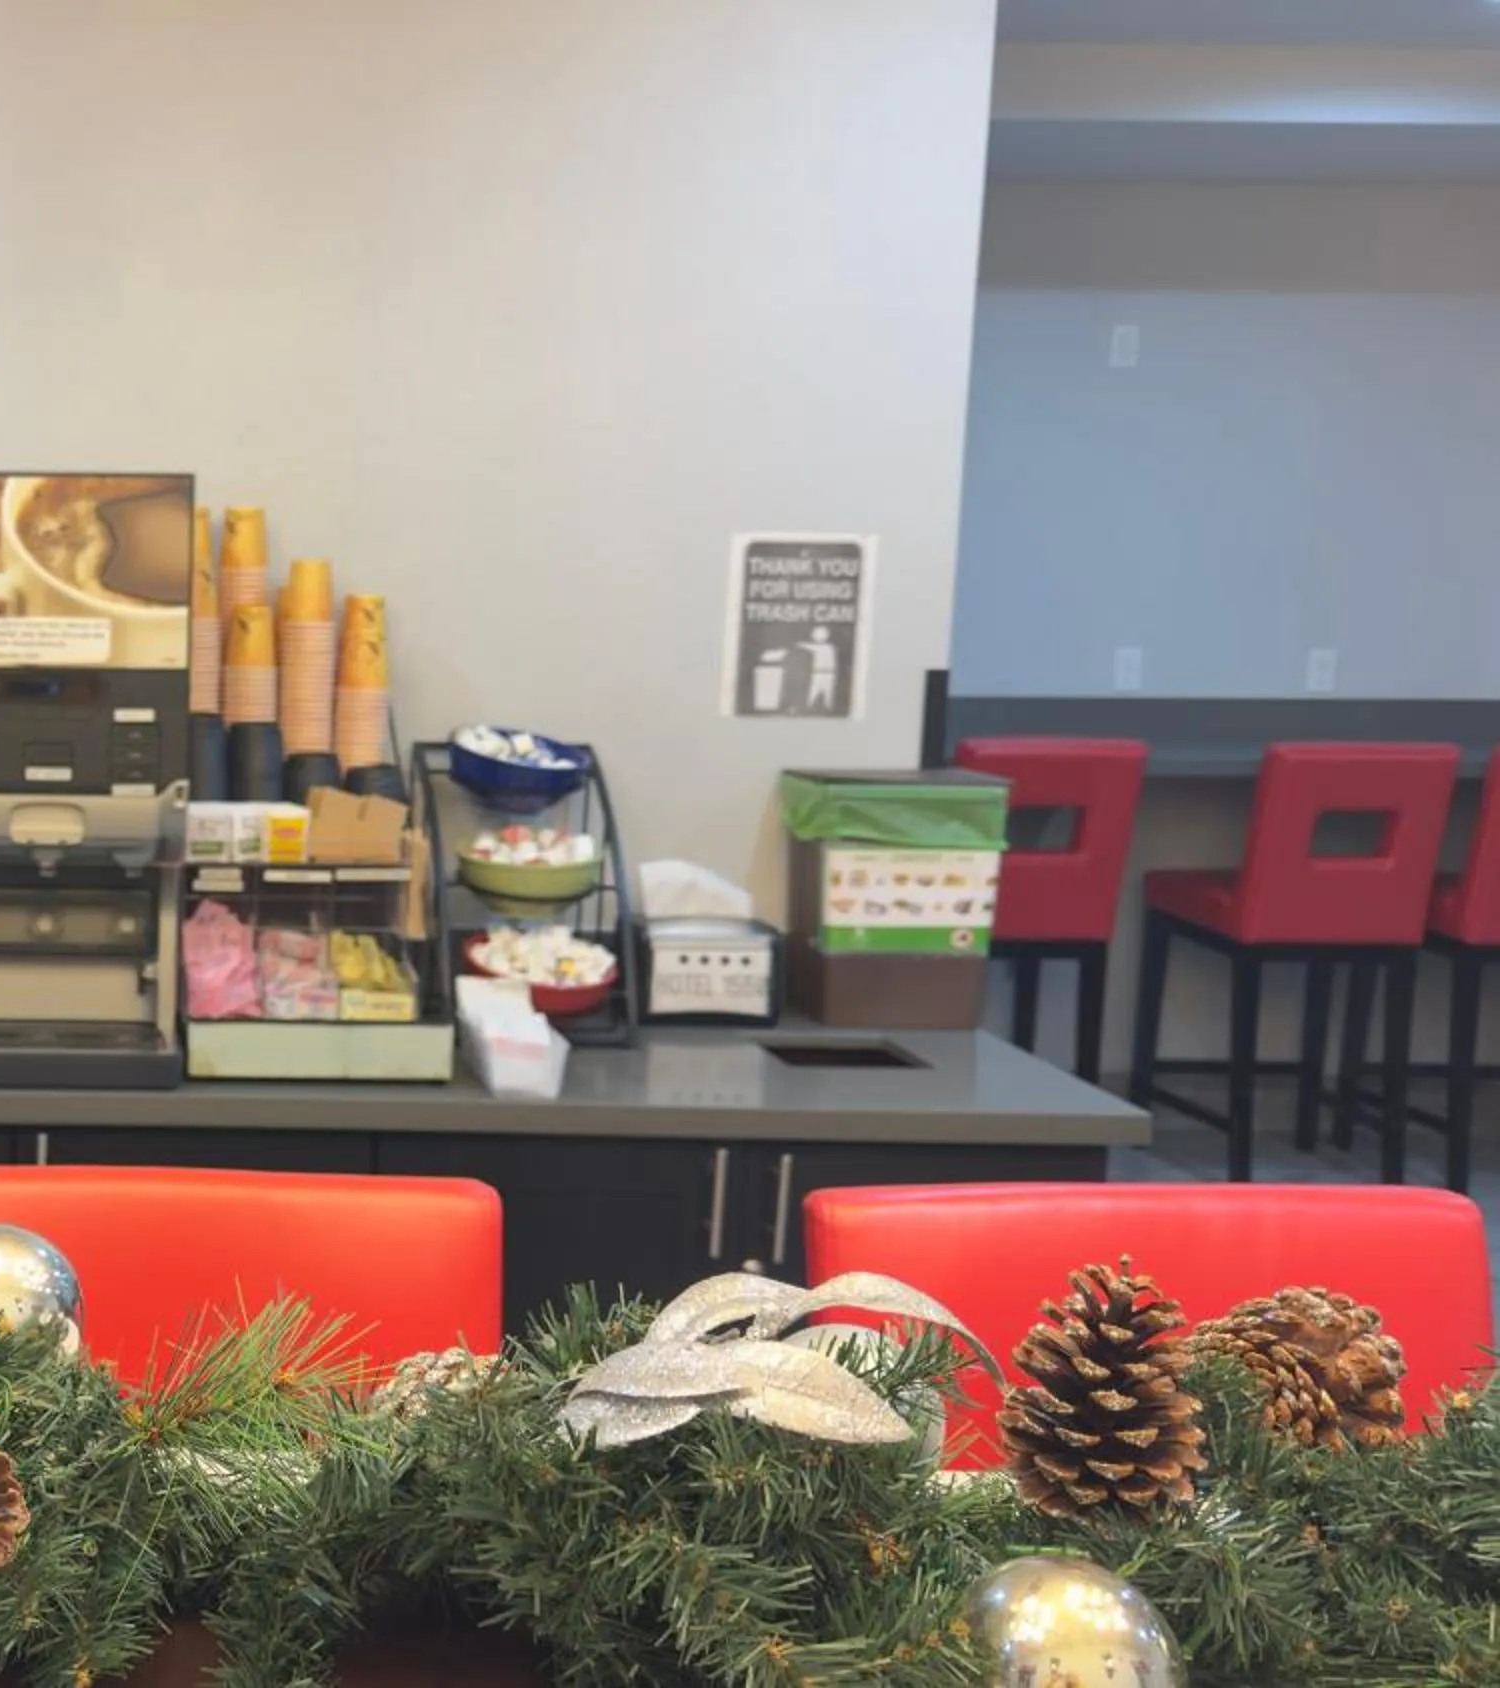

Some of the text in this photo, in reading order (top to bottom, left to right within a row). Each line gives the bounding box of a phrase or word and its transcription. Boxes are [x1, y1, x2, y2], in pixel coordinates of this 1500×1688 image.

[750, 556, 860, 577] THANK YOU
[750, 578, 853, 599] FOR USING
[746, 601, 855, 622] TRASH CAN
